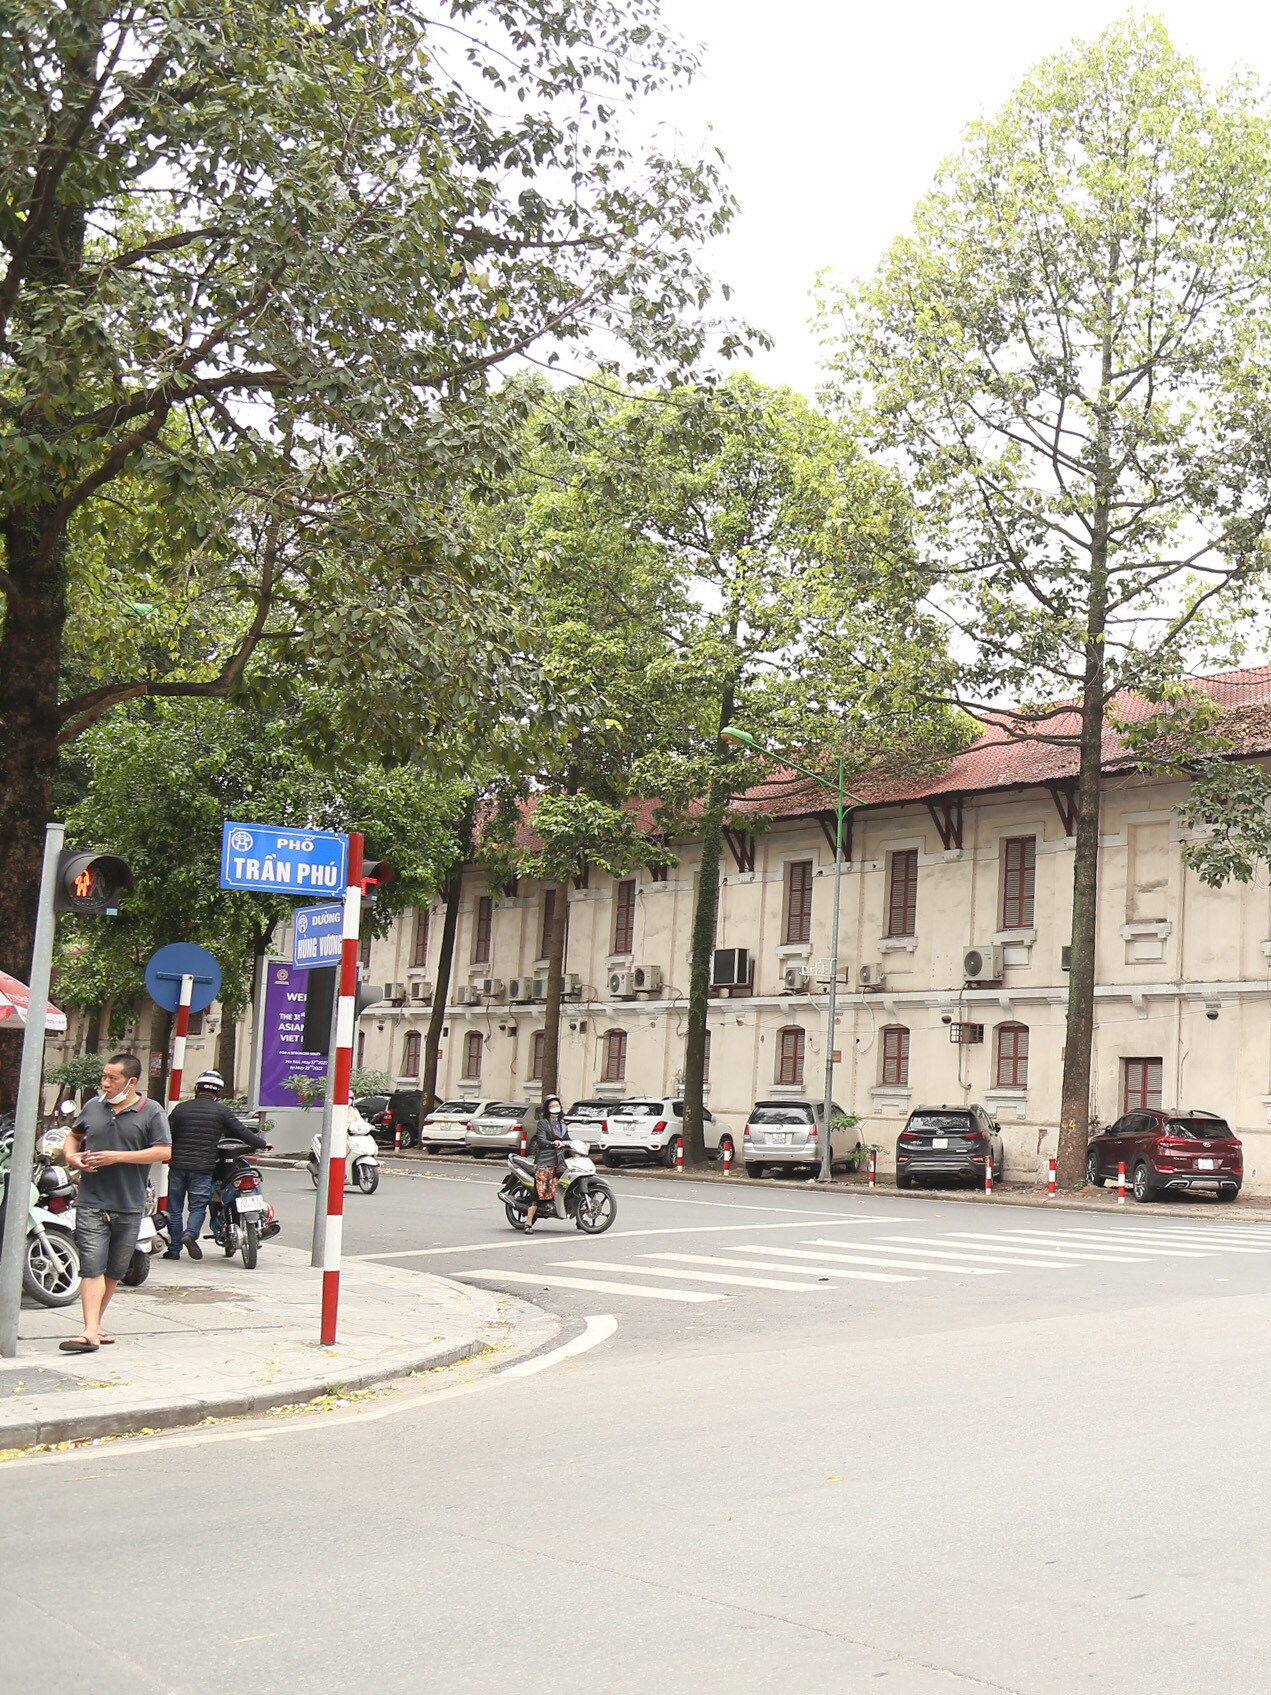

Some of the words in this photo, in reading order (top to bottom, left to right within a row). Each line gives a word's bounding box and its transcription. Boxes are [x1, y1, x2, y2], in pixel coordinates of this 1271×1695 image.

[276, 837, 316, 852] PHỐ
[233, 853, 292, 884] TRẦN
[296, 861, 338, 887] PHÚ
[312, 911, 341, 926] ĐƯỜNG
[297, 934, 318, 960] HÙNG
[279, 1013, 293, 1021] THE
[280, 1034, 300, 1042] VIET
